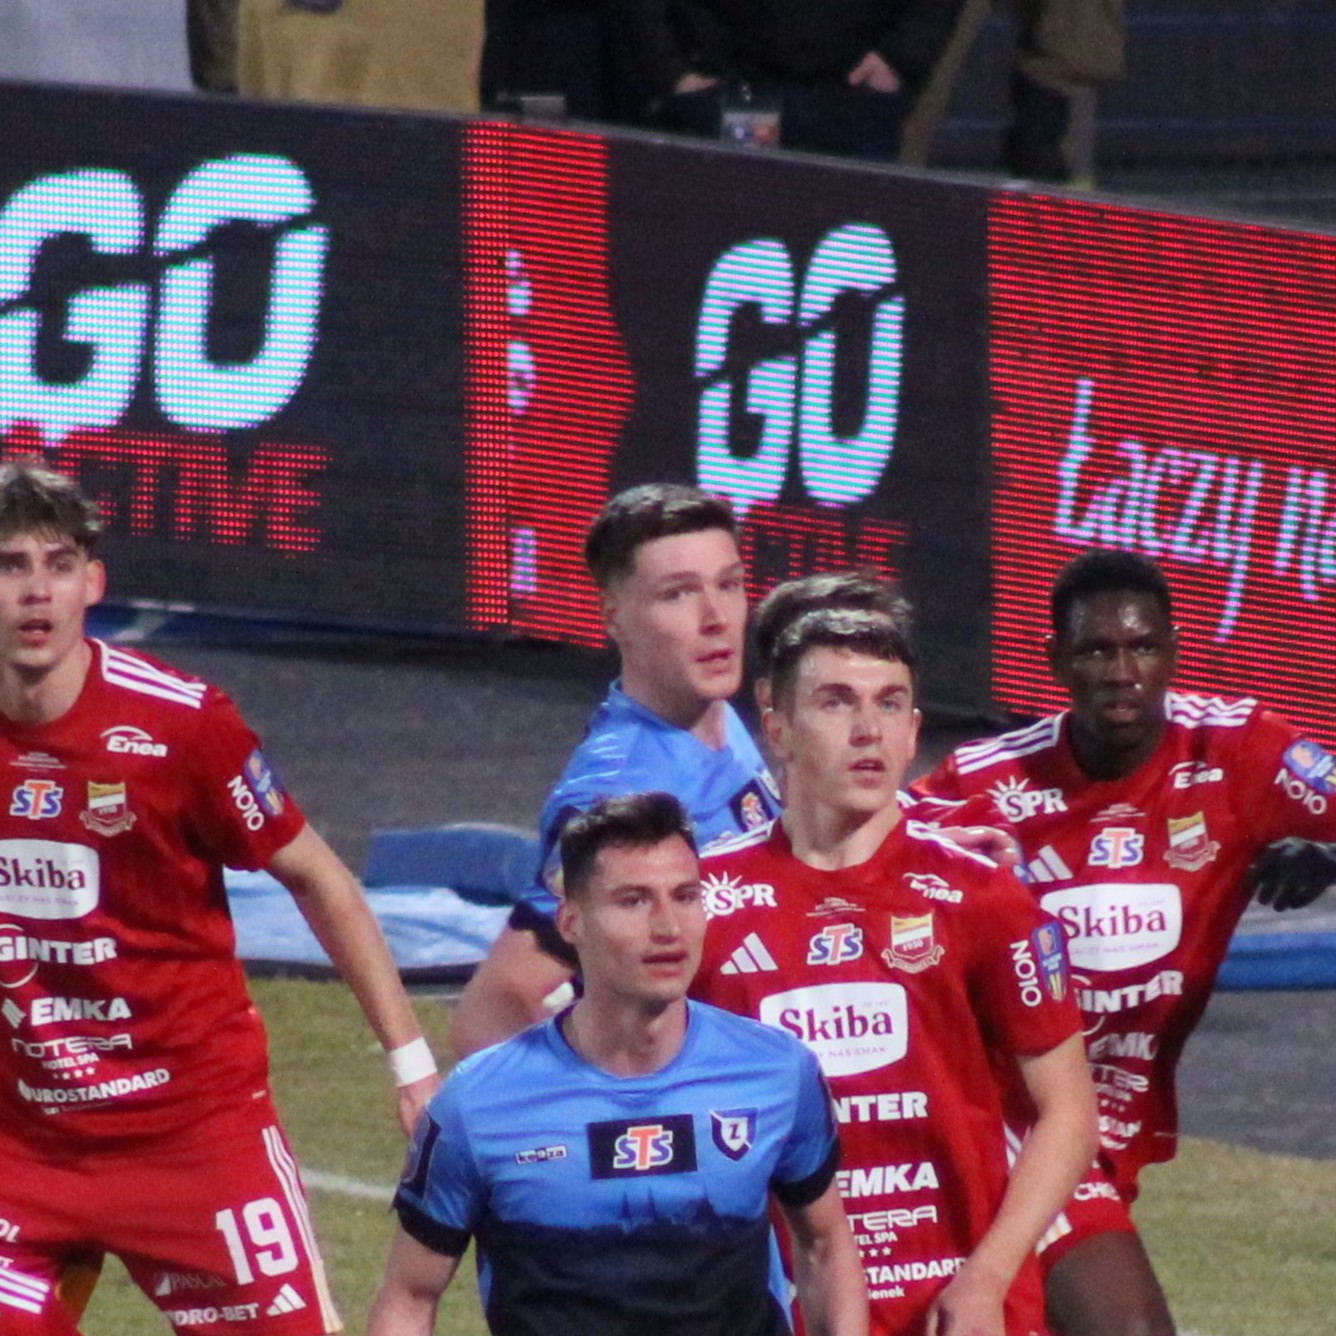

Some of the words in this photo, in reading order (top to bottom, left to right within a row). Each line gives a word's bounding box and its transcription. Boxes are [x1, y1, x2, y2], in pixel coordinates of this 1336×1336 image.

[694, 220, 905, 520] GO
[106, 735, 168, 757] Enea
[9, 779, 63, 820] STS
[1002, 786, 1068, 822] SPR
[1088, 827, 1145, 869] STS
[714, 884, 778, 914] SPR
[1058, 904, 1166, 939] Skiba
[807, 923, 863, 966] STS
[1075, 970, 1183, 1013] INTER
[31, 997, 132, 1026] EMKA
[779, 1005, 893, 1044] Skiba
[76, 1052, 100, 1064] SPA
[1089, 1032, 1156, 1060] EMK
[834, 1091, 928, 1123] NTER
[614, 1125, 672, 1171] STS
[847, 1205, 938, 1232] TERA
[215, 1197, 298, 1286] 19
[875, 1231, 898, 1243] SPA
[171, 1273, 227, 1291] PASCAL
